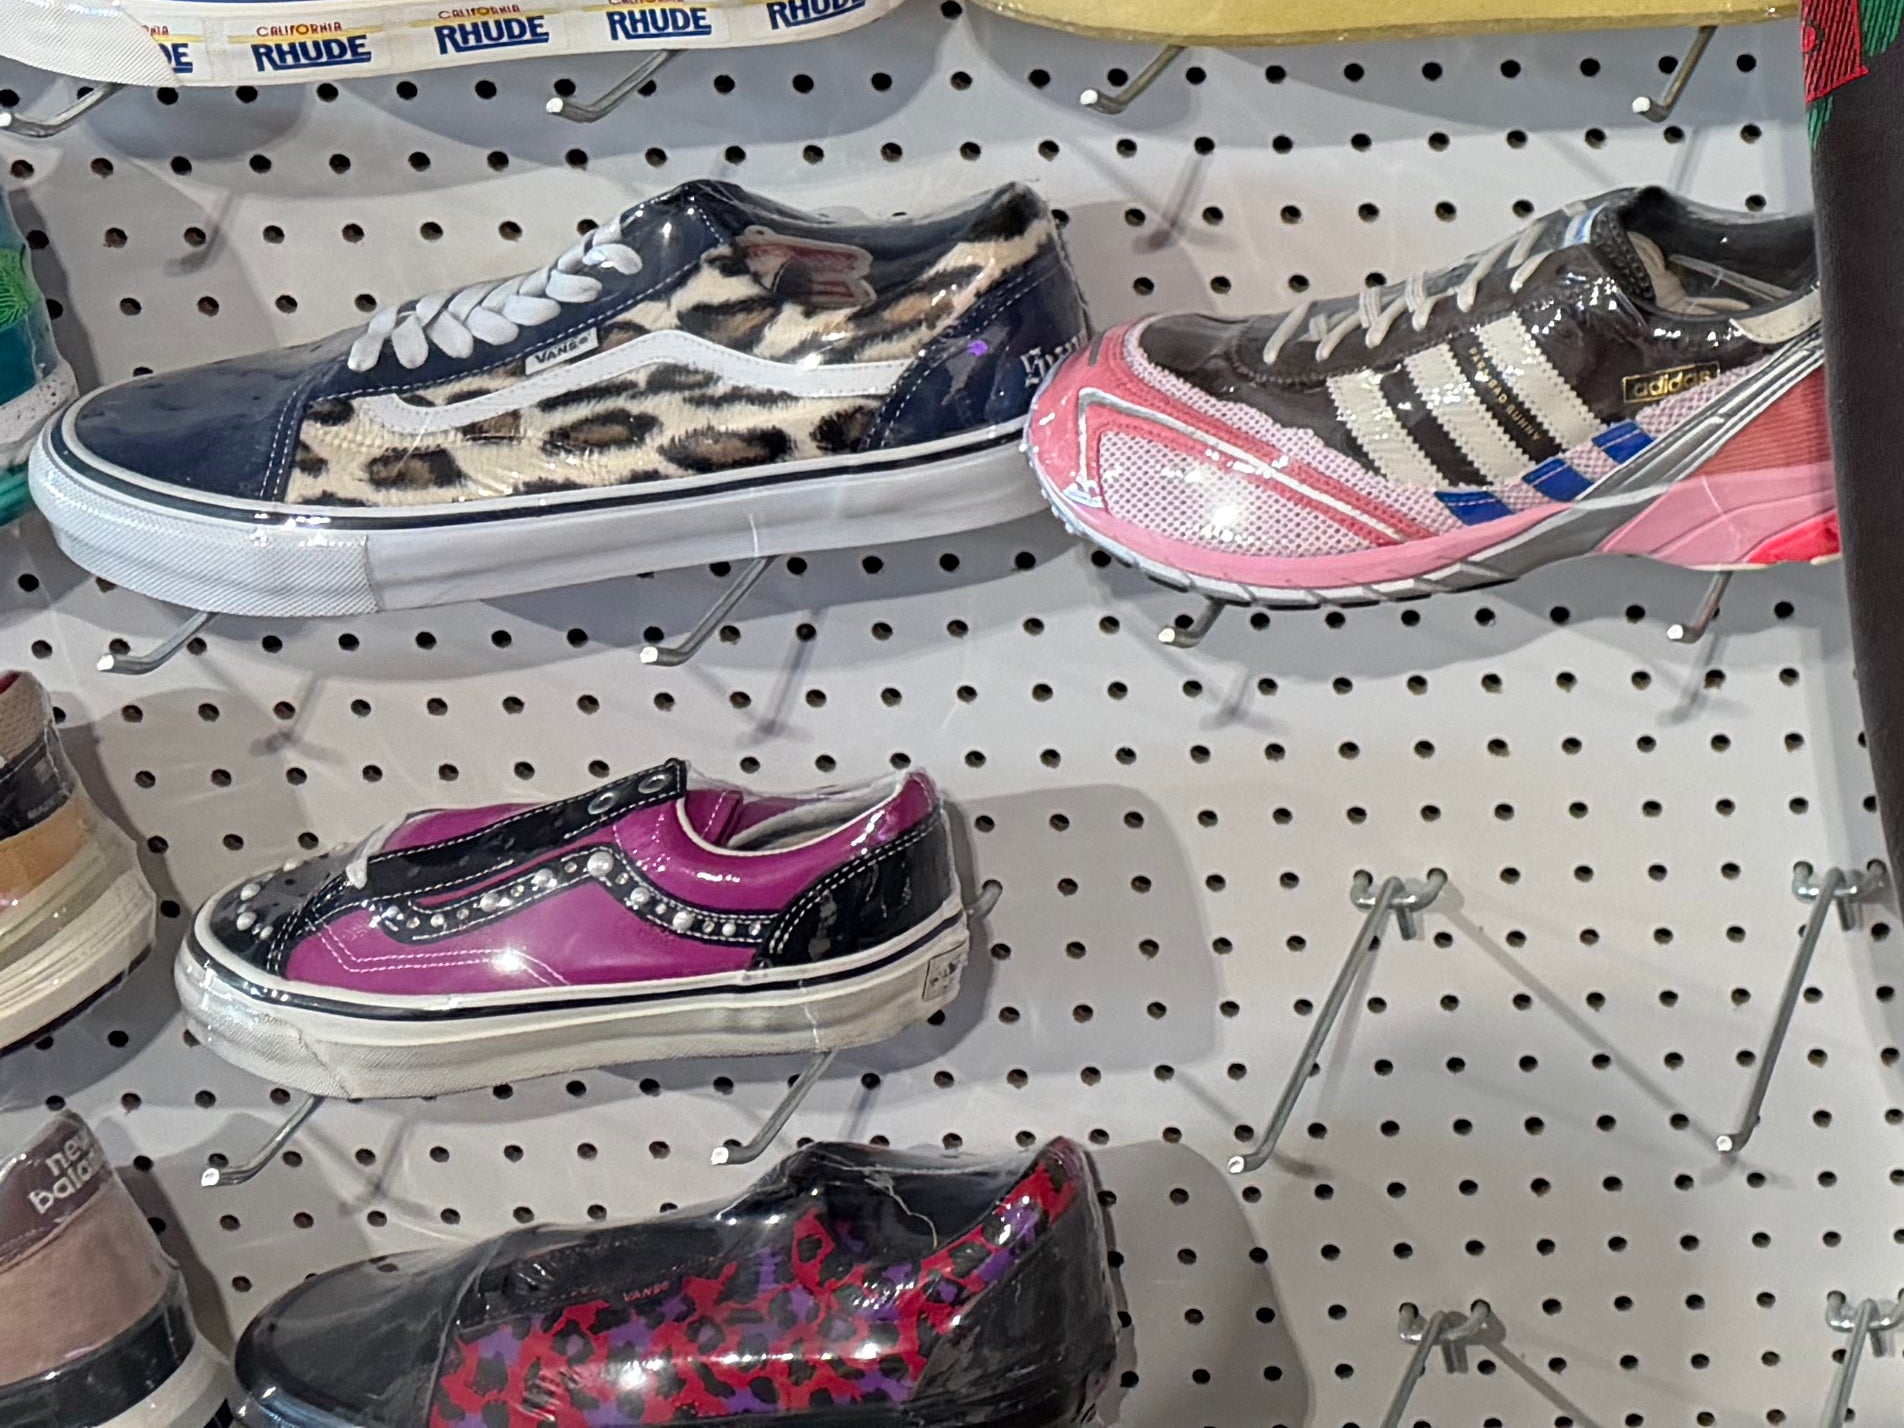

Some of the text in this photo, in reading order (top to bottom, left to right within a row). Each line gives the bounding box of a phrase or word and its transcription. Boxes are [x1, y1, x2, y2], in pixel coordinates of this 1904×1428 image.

[437, 3, 522, 19] CALIFORNIA
[606, 7, 713, 41] RHUDE
[256, 21, 342, 37] CALIFORNIA
[434, 15, 550, 55] RHUDE
[251, 35, 372, 72] RHUDE
[1634, 370, 1711, 398] adidas
